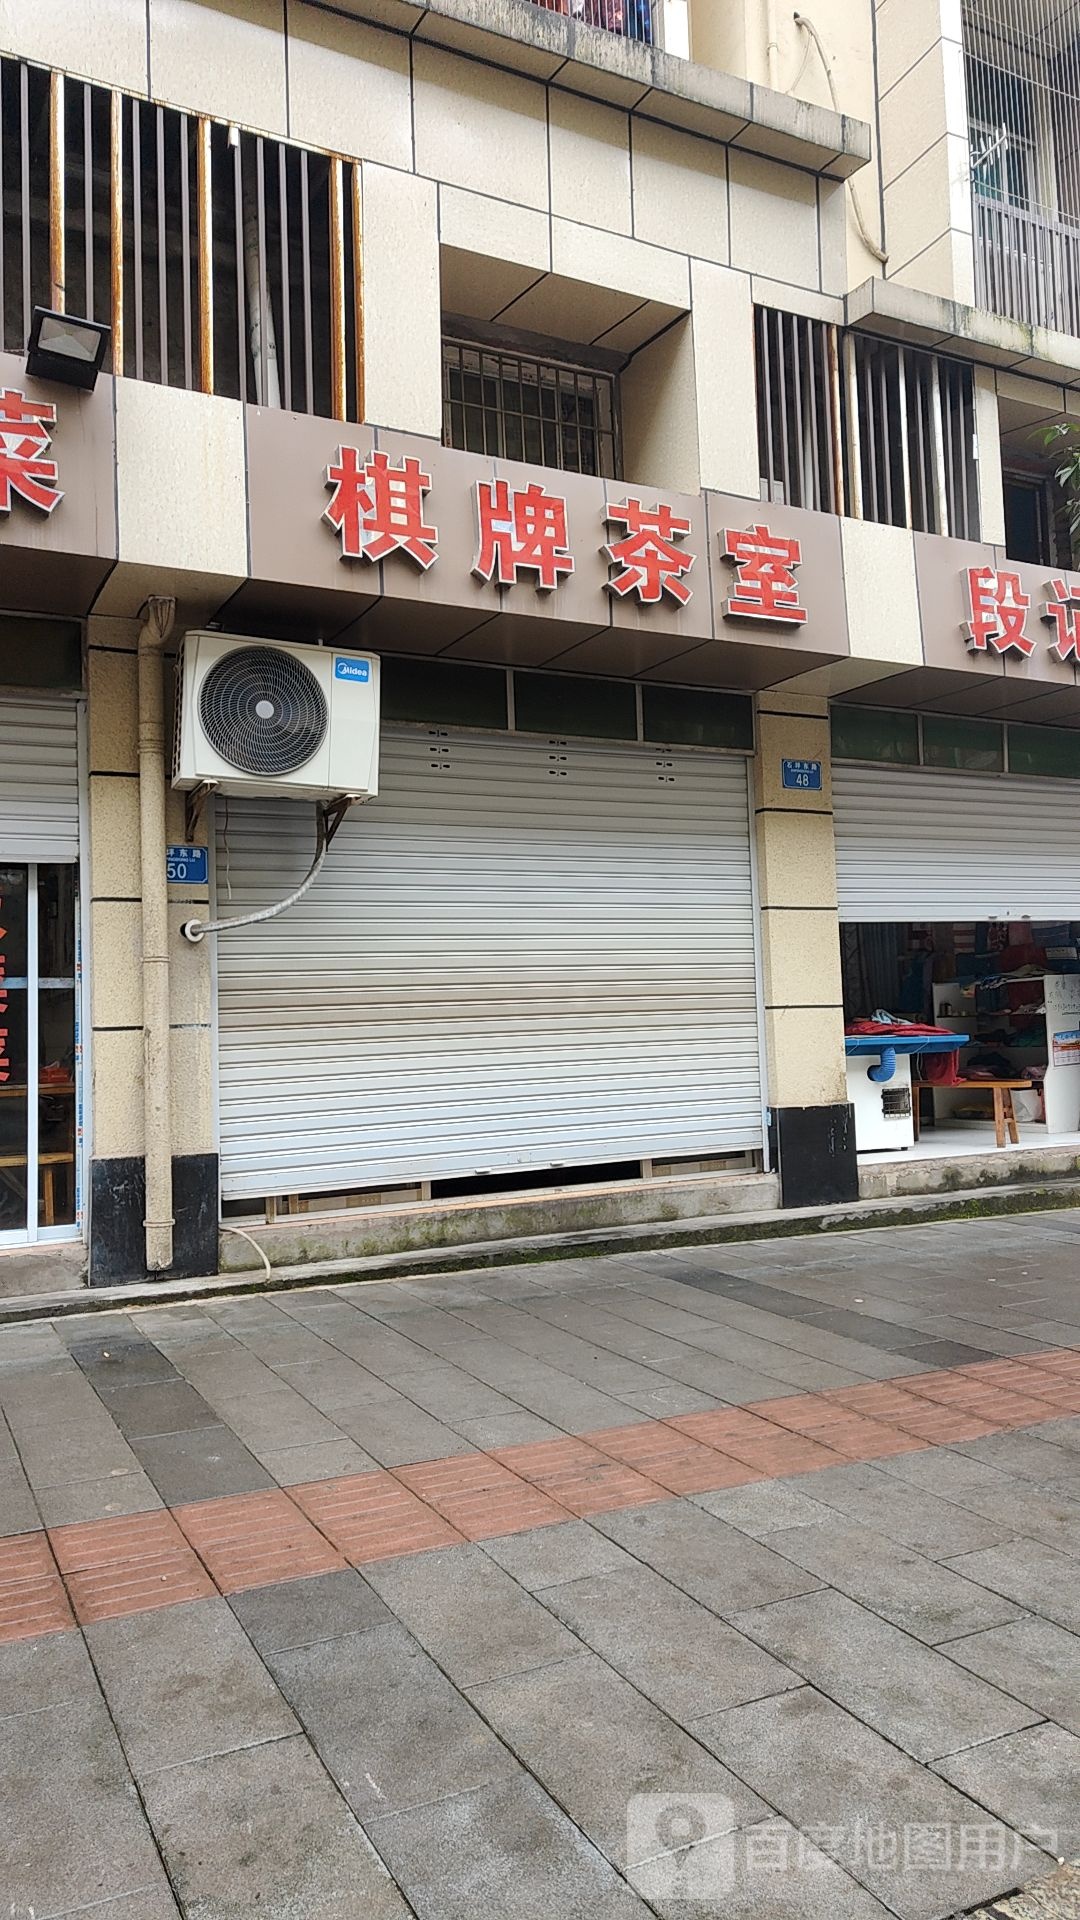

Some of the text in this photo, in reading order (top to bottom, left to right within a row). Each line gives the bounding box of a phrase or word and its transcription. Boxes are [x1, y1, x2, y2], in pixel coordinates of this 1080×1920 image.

[323, 444, 808, 625] 棋牌茶室
[337, 662, 368, 677] Midea
[796, 773, 809, 787] 48
[167, 863, 187, 879] 50
